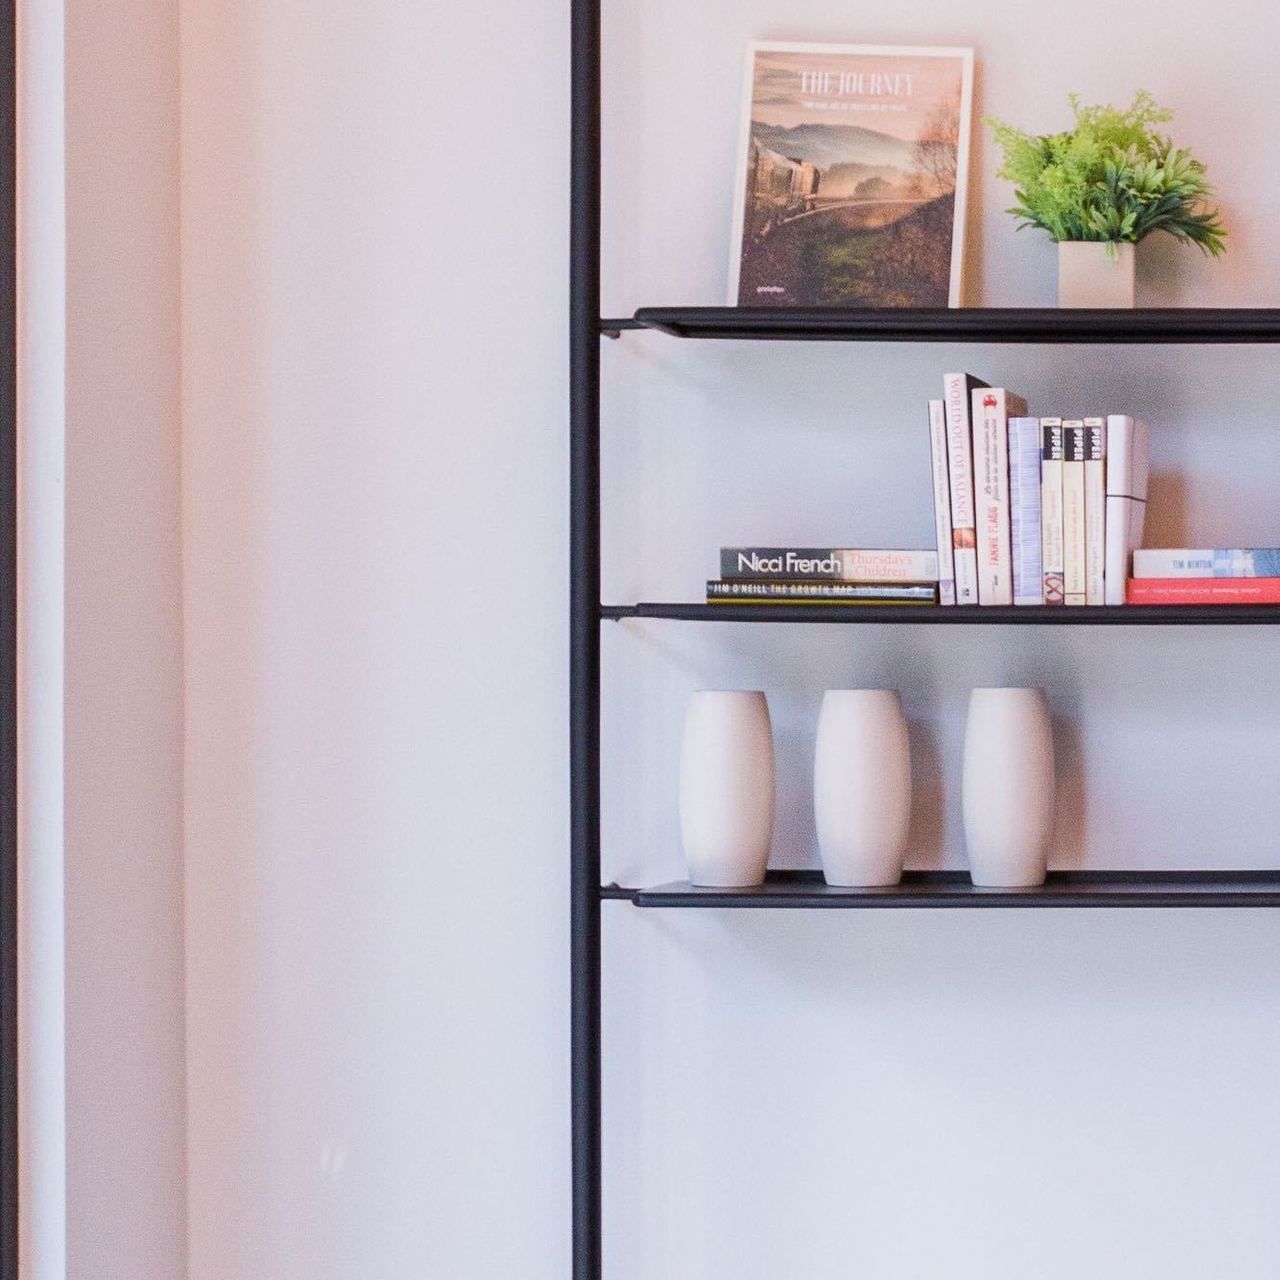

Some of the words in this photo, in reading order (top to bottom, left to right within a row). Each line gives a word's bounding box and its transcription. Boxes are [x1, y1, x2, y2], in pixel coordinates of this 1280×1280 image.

[800, 71, 834, 94] THE
[839, 72, 914, 96] JOURNEY
[951, 378, 962, 423] WORLD
[951, 425, 963, 451] OUT
[1051, 427, 1061, 459] PIPER
[1073, 428, 1083, 460] PIPER
[1091, 427, 1101, 459] PIPER
[953, 454, 964, 470] OF
[954, 472, 968, 523] BALANCE
[988, 506, 998, 534] FLAGG
[738, 552, 783, 572] Nicci
[786, 552, 842, 573] French
[713, 584, 730, 593] JIM
[732, 584, 768, 593] O'NEILL
[771, 585, 787, 593] THE
